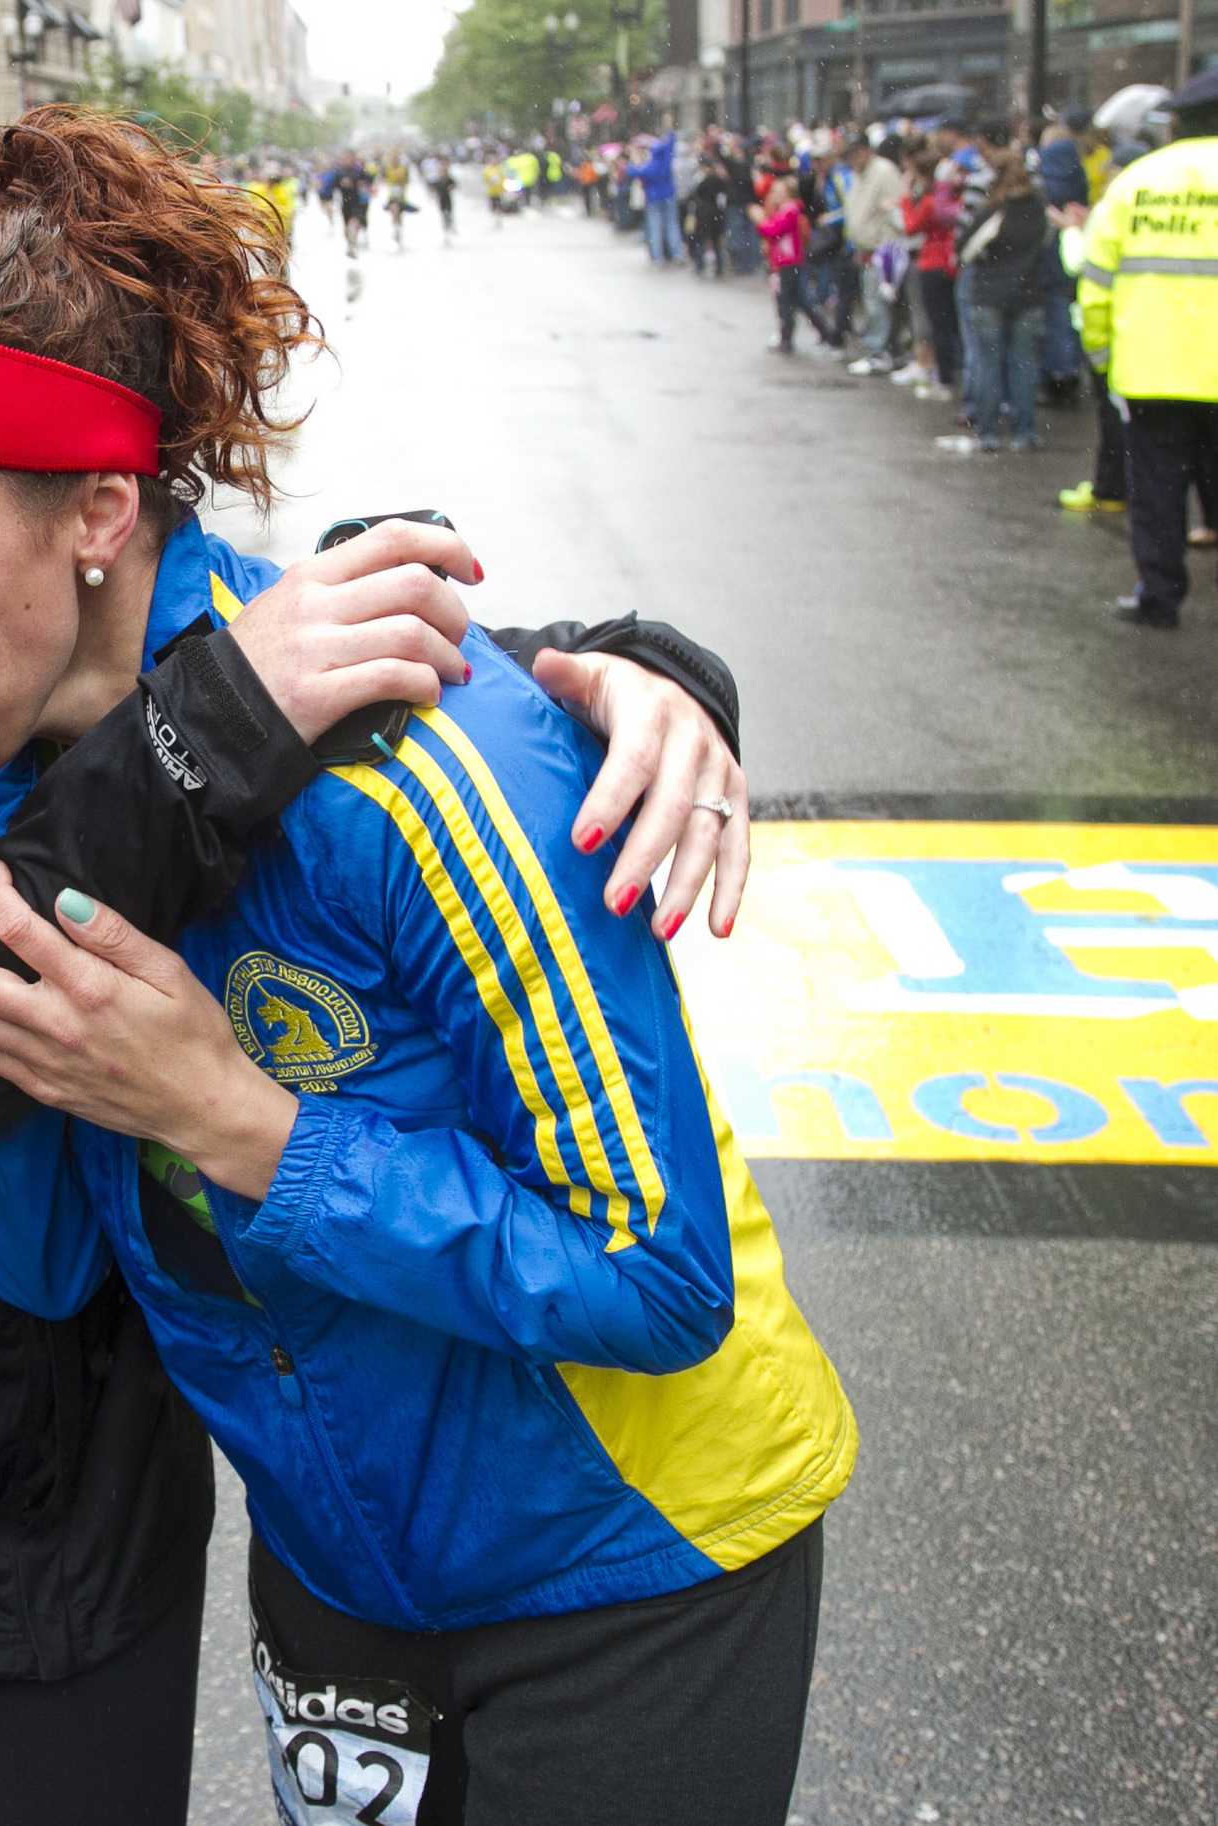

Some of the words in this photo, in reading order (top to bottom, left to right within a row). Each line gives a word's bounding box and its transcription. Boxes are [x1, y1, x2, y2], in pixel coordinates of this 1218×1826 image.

[1131, 214, 1218, 234] Polic
[232, 958, 276, 993] ATHLETIC
[230, 993, 256, 1055] BOSTON
[278, 964, 361, 1040] ASSOCIATION
[276, 1065, 314, 1079] BOSTON
[315, 1048, 374, 1076] MARATHON
[256, 1640, 409, 1735] adidas
